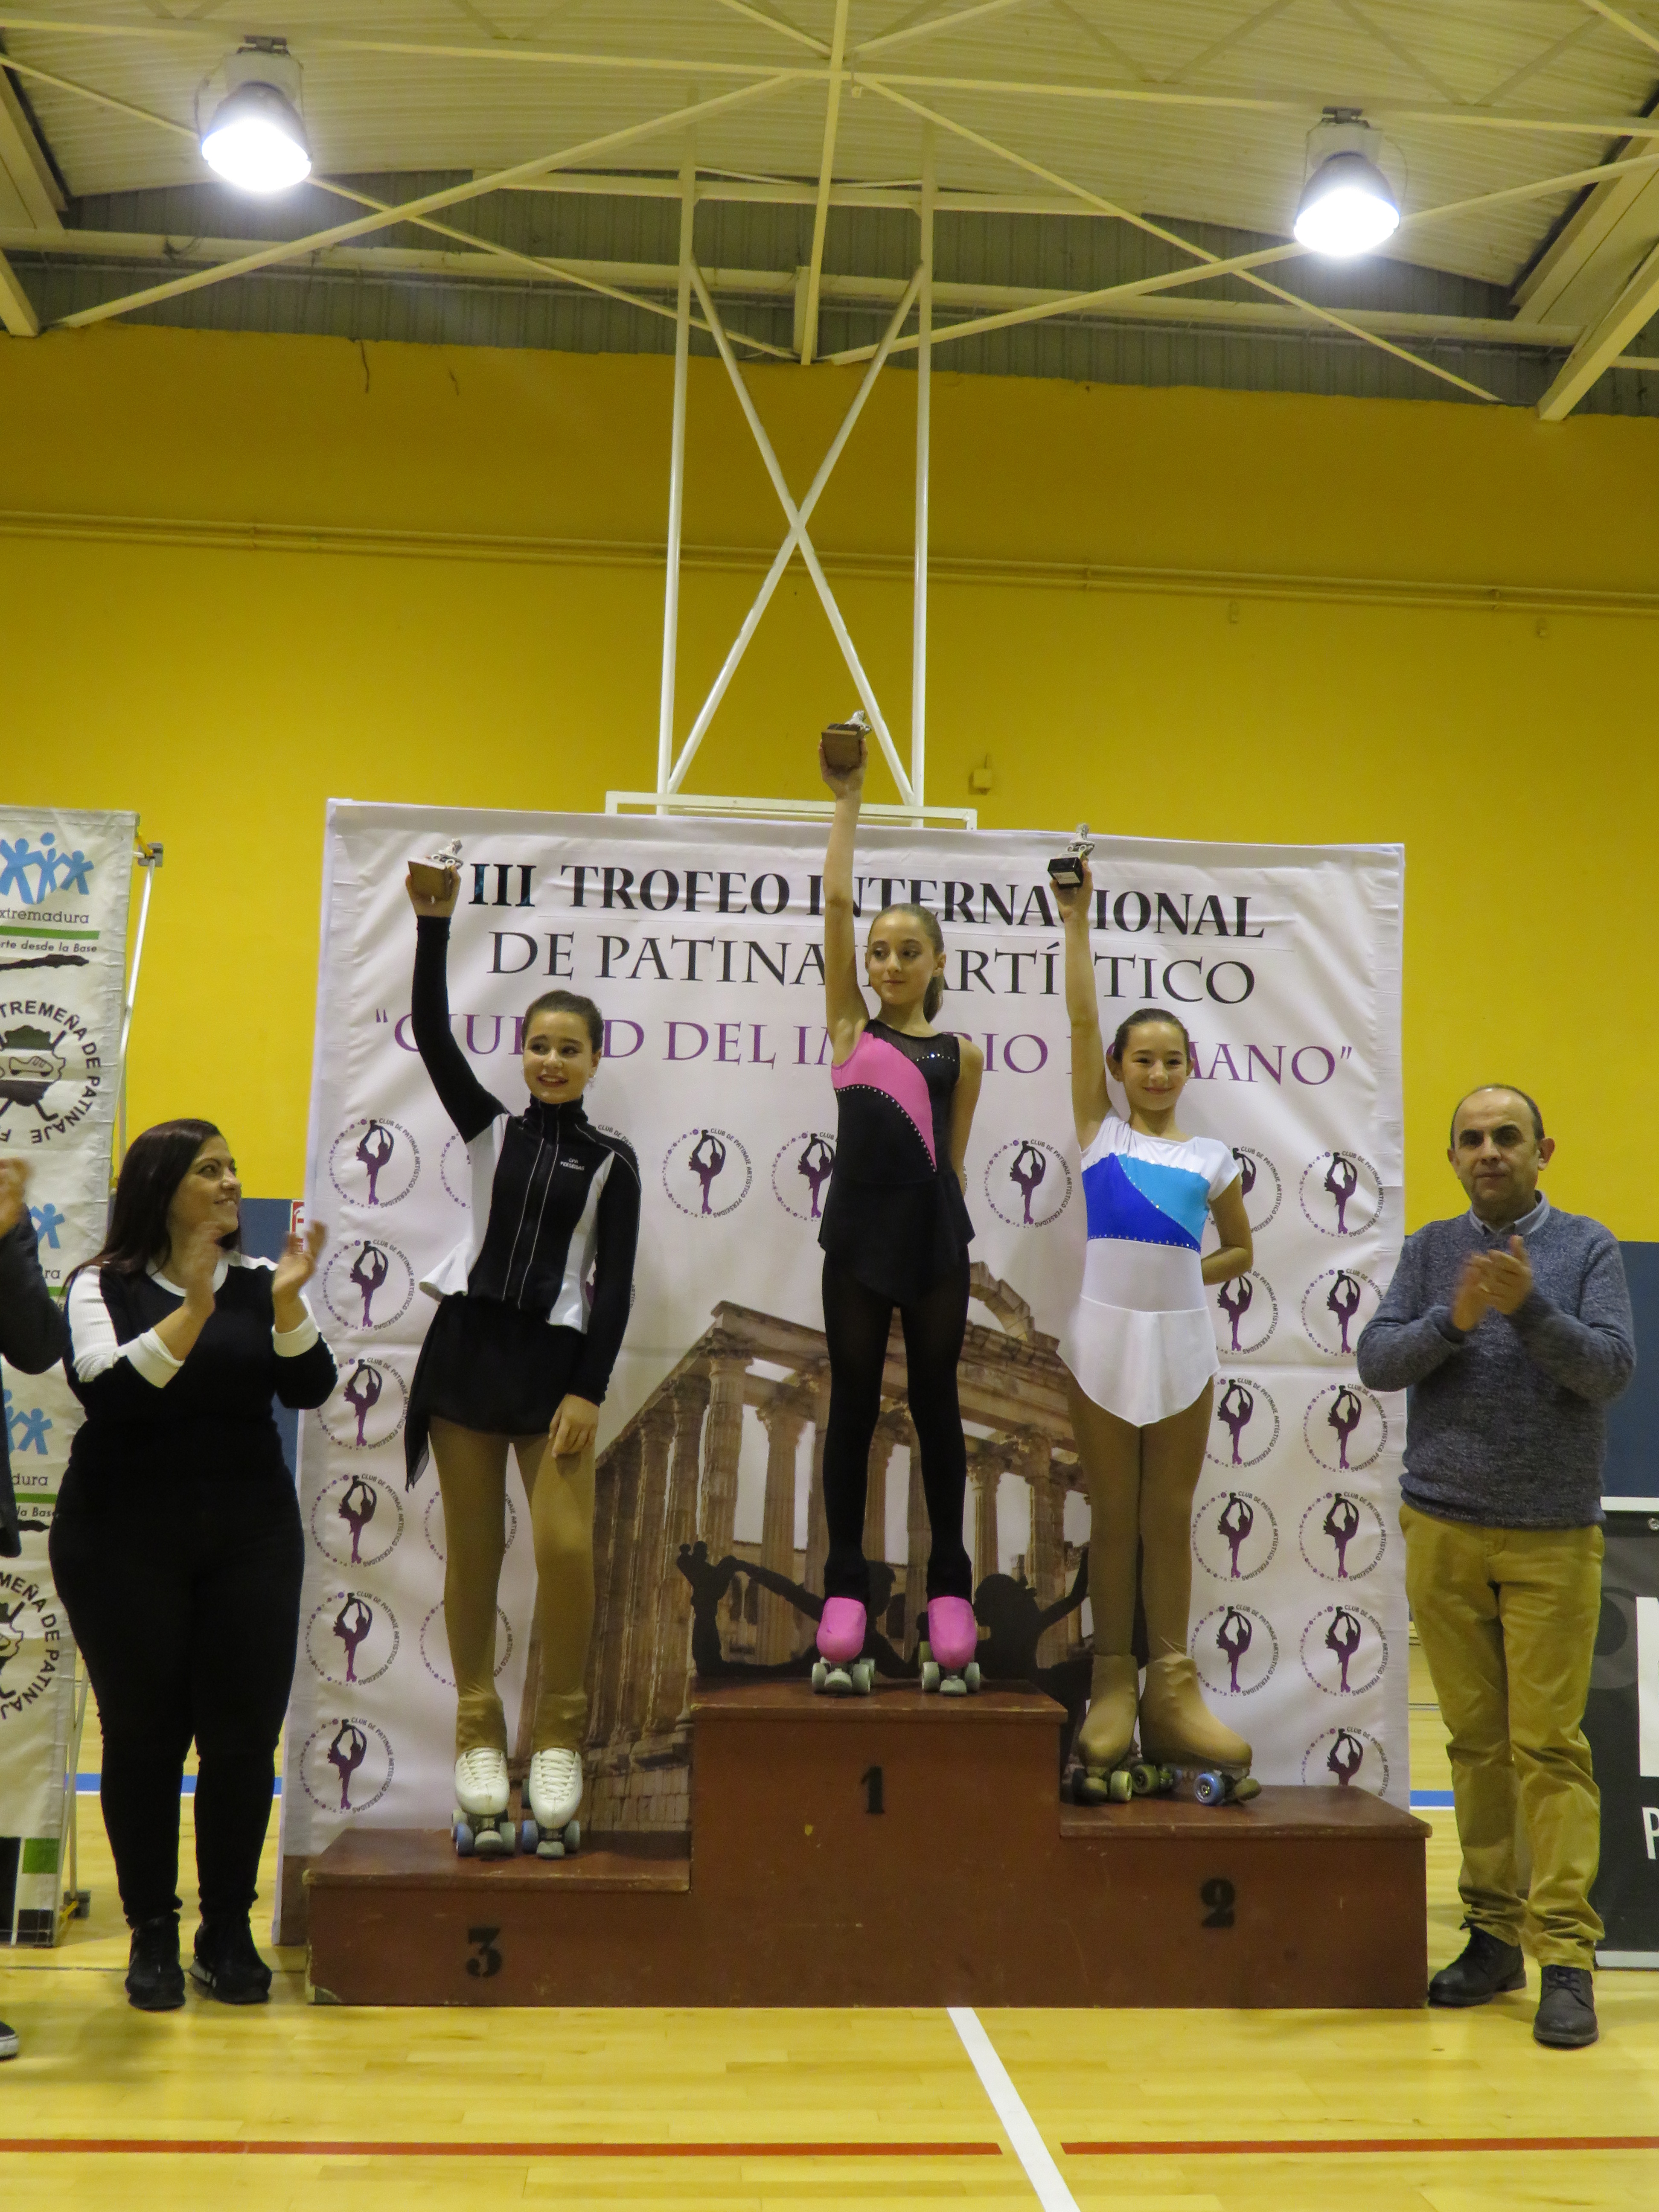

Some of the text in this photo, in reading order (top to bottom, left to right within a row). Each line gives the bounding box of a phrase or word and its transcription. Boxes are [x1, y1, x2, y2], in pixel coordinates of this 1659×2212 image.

[469, 863, 1264, 938] III TROFEO ITERNAIONAL
[21, 940, 55, 952] desde
[58, 942, 69, 952] la
[73, 943, 98, 953] Base
[487, 931, 574, 981] DE
[944, 941, 1255, 1004] RTÍTICO
[81, 1042, 102, 1069] DE
[662, 1021, 776, 1069] DEL
[30, 1075, 101, 1144] PATINAJE
[711, 1128, 725, 1136] CLUB
[733, 1139, 751, 1164] PATINAJE
[1053, 1150, 1071, 1175] PATINAJE
[1241, 1146, 1256, 1155] CLUB
[1263, 1157, 1281, 1182] PATINAJE
[1364, 1162, 1382, 1186] PATINAJE
[713, 1198, 742, 1218] PERSEIDAS
[1035, 1208, 1063, 1228] PERSEIDAS
[1251, 1214, 1274, 1233] PERSEIDA
[1349, 1218, 1376, 1237] PERSEIDAS
[1260, 1389, 1278, 1414] PATINAJE
[1244, 1447, 1271, 1467] PERSEIDAS
[41, 1613, 60, 1643] DE
[861, 1765, 886, 1815] 1
[1200, 1878, 1237, 1928] 2
[466, 1927, 503, 1978] 3
